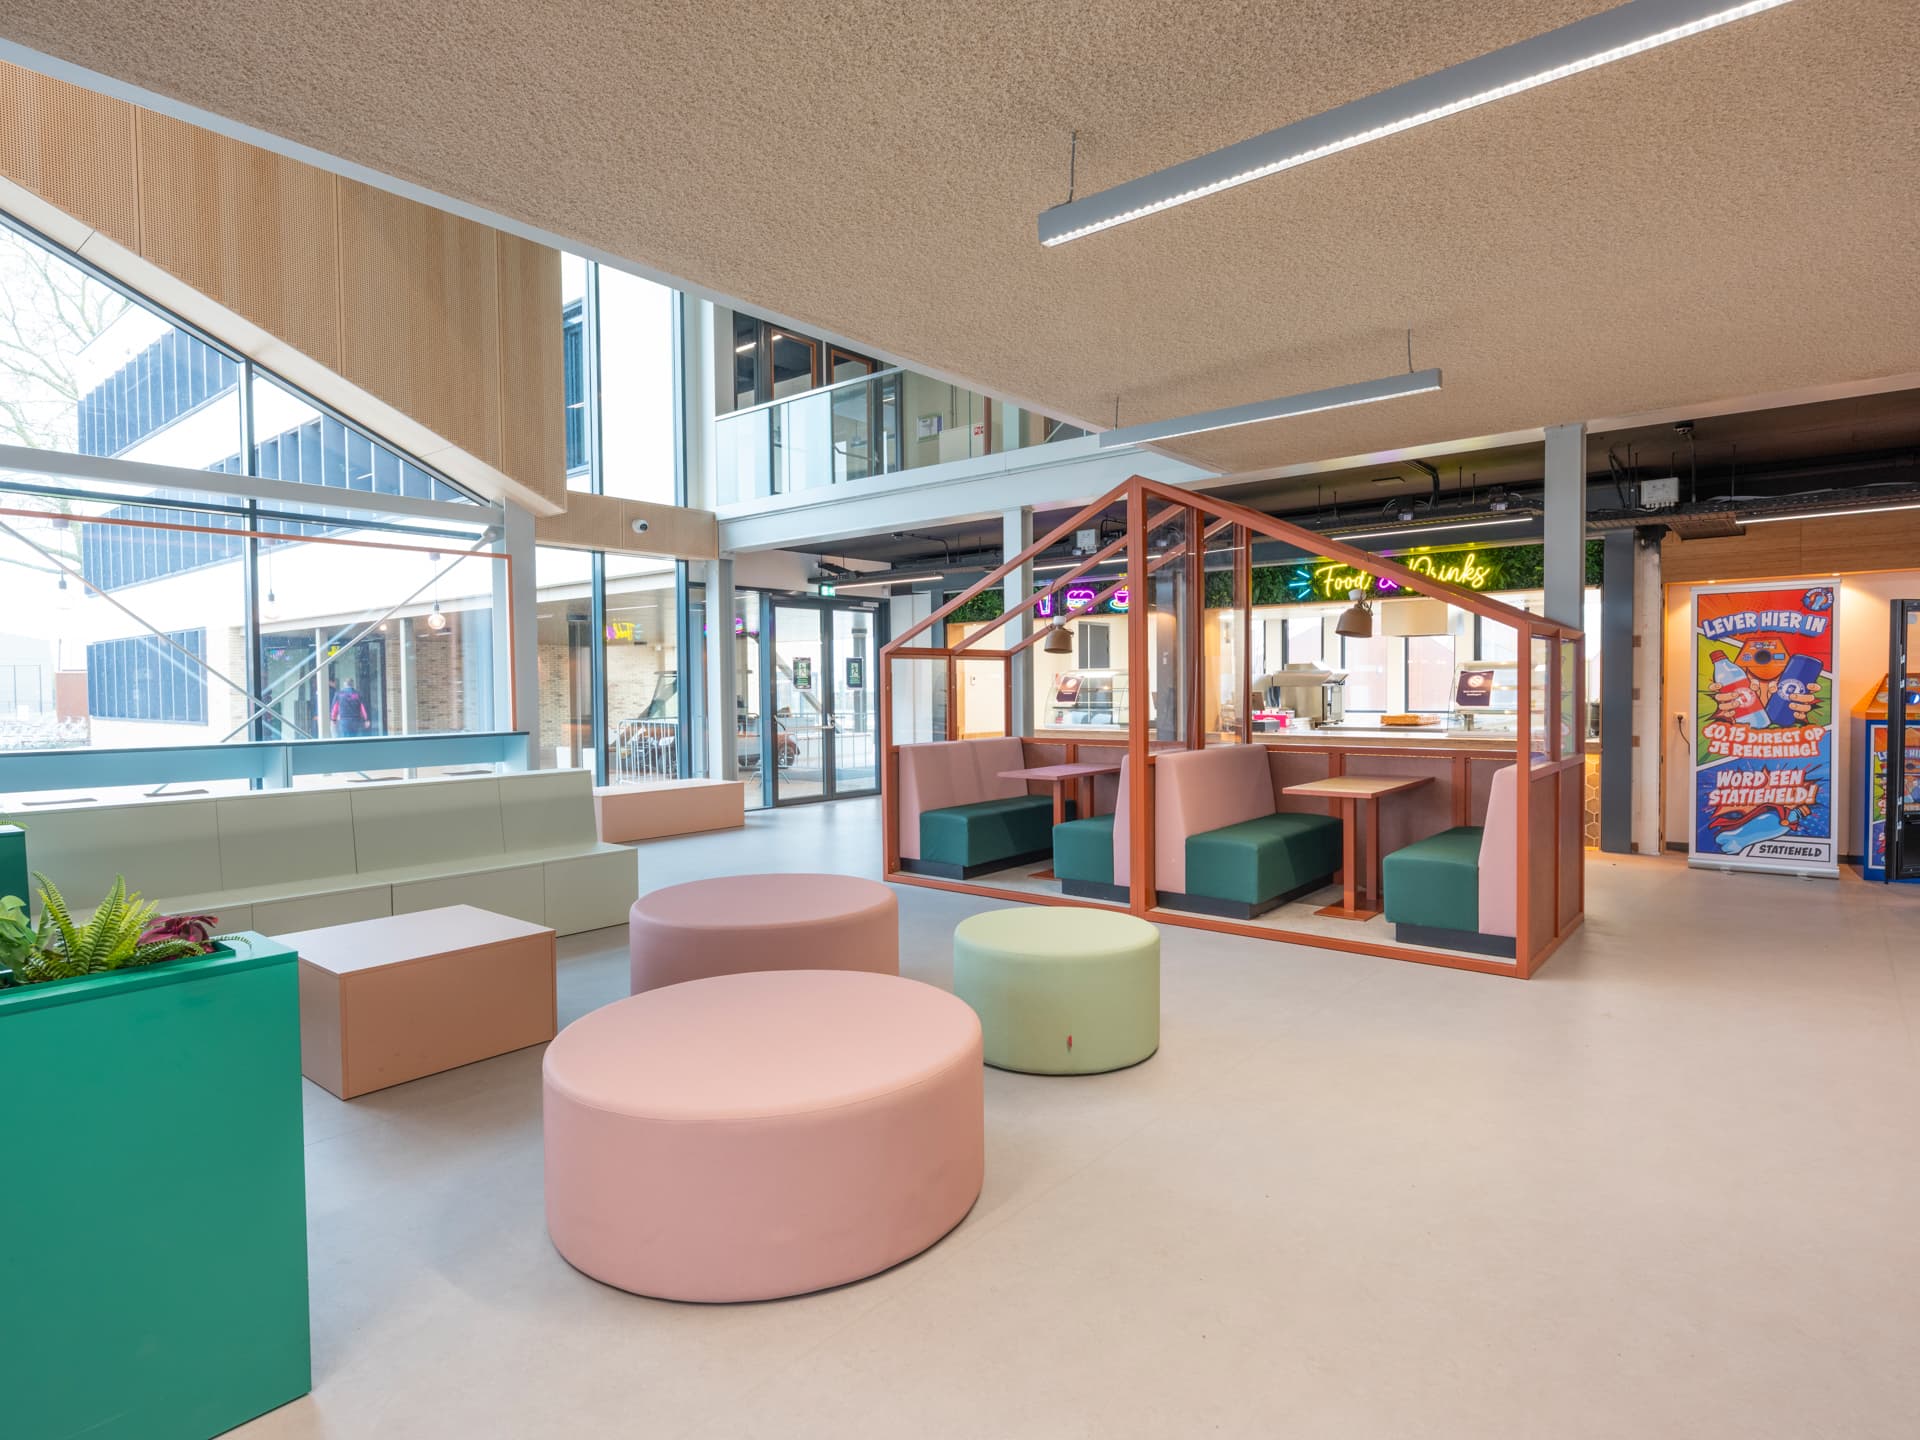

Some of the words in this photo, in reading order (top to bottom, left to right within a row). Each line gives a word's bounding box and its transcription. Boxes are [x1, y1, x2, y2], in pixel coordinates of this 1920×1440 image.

[1316, 564, 1371, 597] Food
[1703, 612, 1757, 638] LEVER
[1761, 611, 1802, 629] HIER
[1805, 615, 1826, 633] IN
[1704, 723, 1746, 742] €0,15
[1748, 731, 1800, 743] DIRECT
[1804, 728, 1824, 740] OP
[1709, 741, 1730, 755] JE
[1732, 741, 1818, 757] REKENING!
[1717, 770, 1766, 787] WORD
[1769, 769, 1803, 786] EEN
[1709, 784, 1818, 805] STATIEHELD!
[1759, 844, 1822, 857] STATIEHELD
